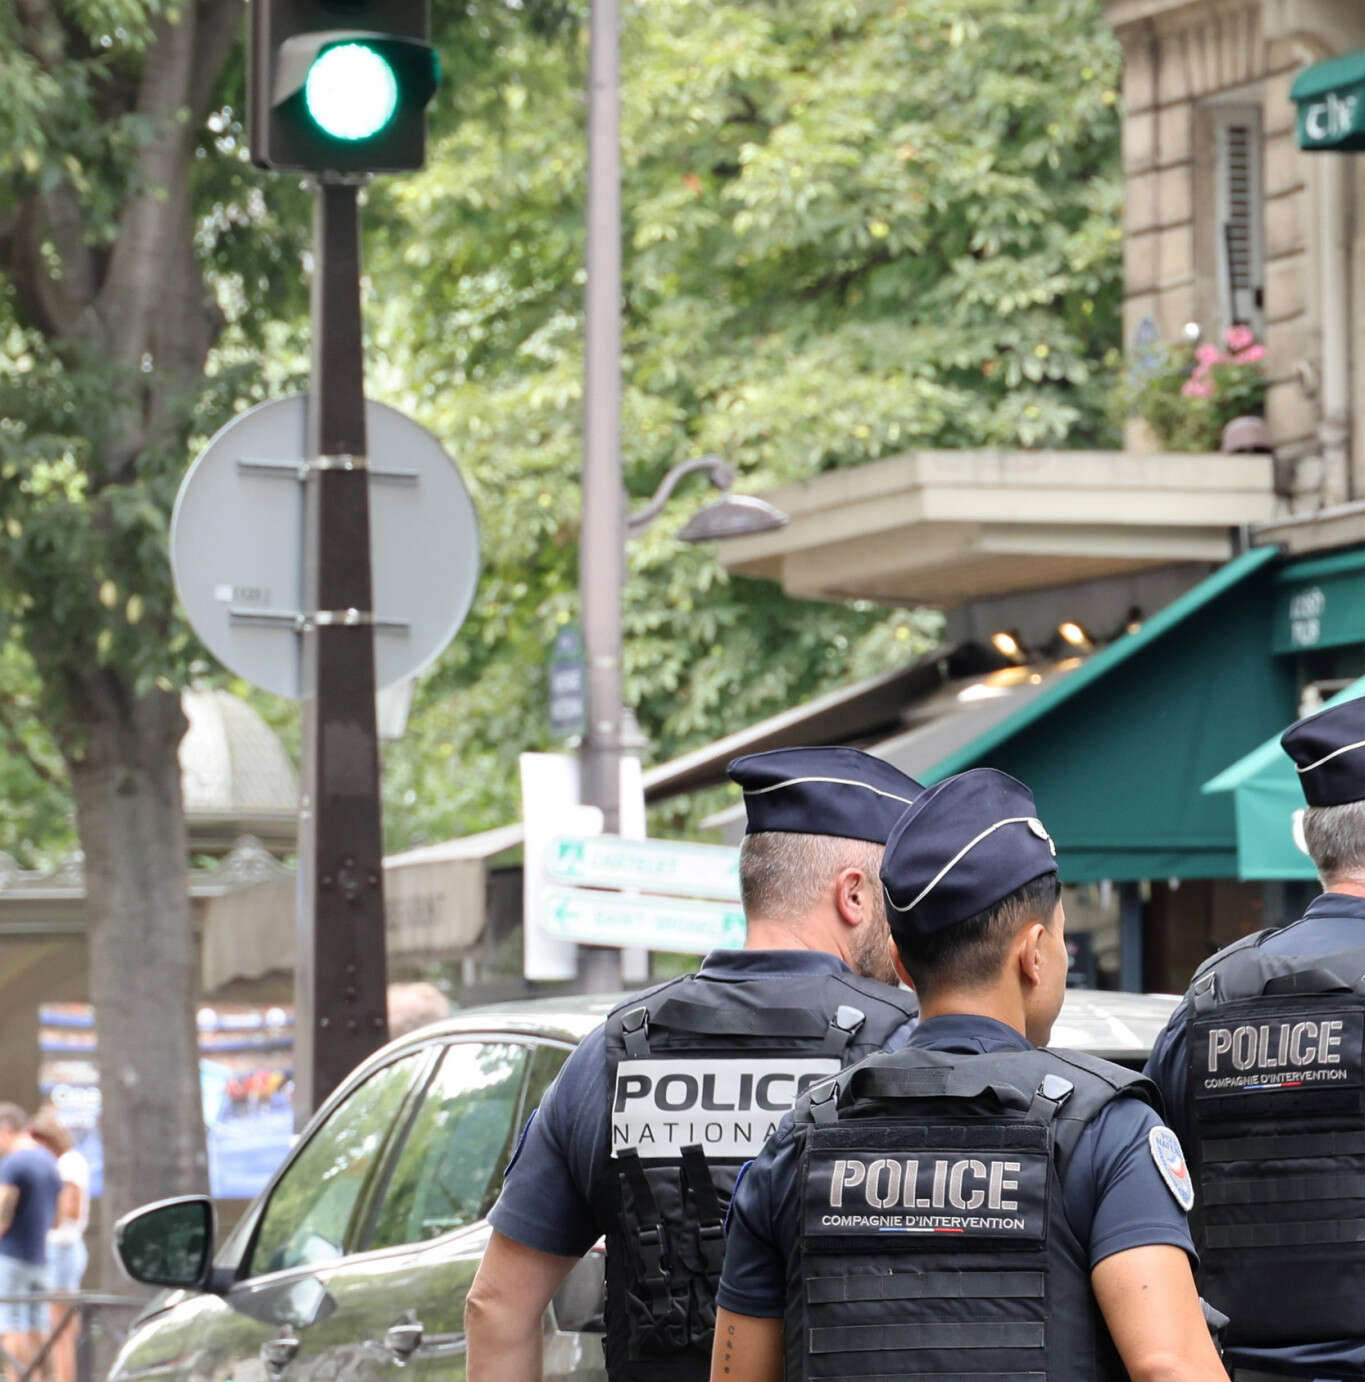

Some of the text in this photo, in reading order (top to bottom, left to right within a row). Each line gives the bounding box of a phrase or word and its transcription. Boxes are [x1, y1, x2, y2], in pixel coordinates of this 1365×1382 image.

[1208, 1021, 1343, 1072] POLICE
[1204, 1069, 1348, 1089] COMPAGNIE D'INTERVENTION
[829, 1158, 1021, 1211] POLICE
[822, 1214, 1025, 1229] COMPAGNIE D'INTERVENTION
